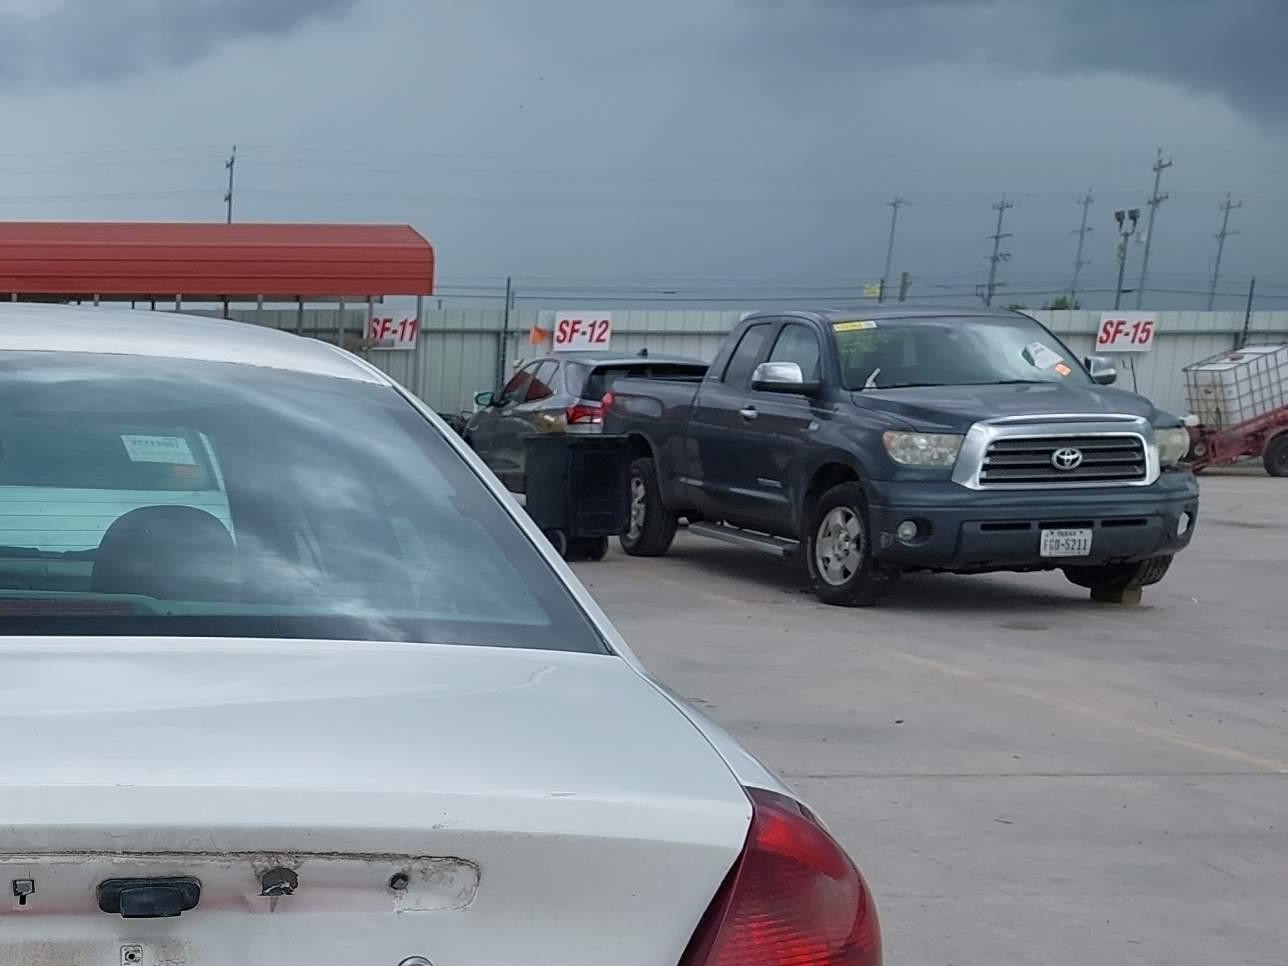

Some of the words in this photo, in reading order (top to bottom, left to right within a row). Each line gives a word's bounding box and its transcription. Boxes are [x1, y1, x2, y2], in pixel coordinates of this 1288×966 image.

[369, 317, 418, 342] SF-11
[556, 319, 610, 344] SF-12
[1098, 319, 1154, 344] SF-15
